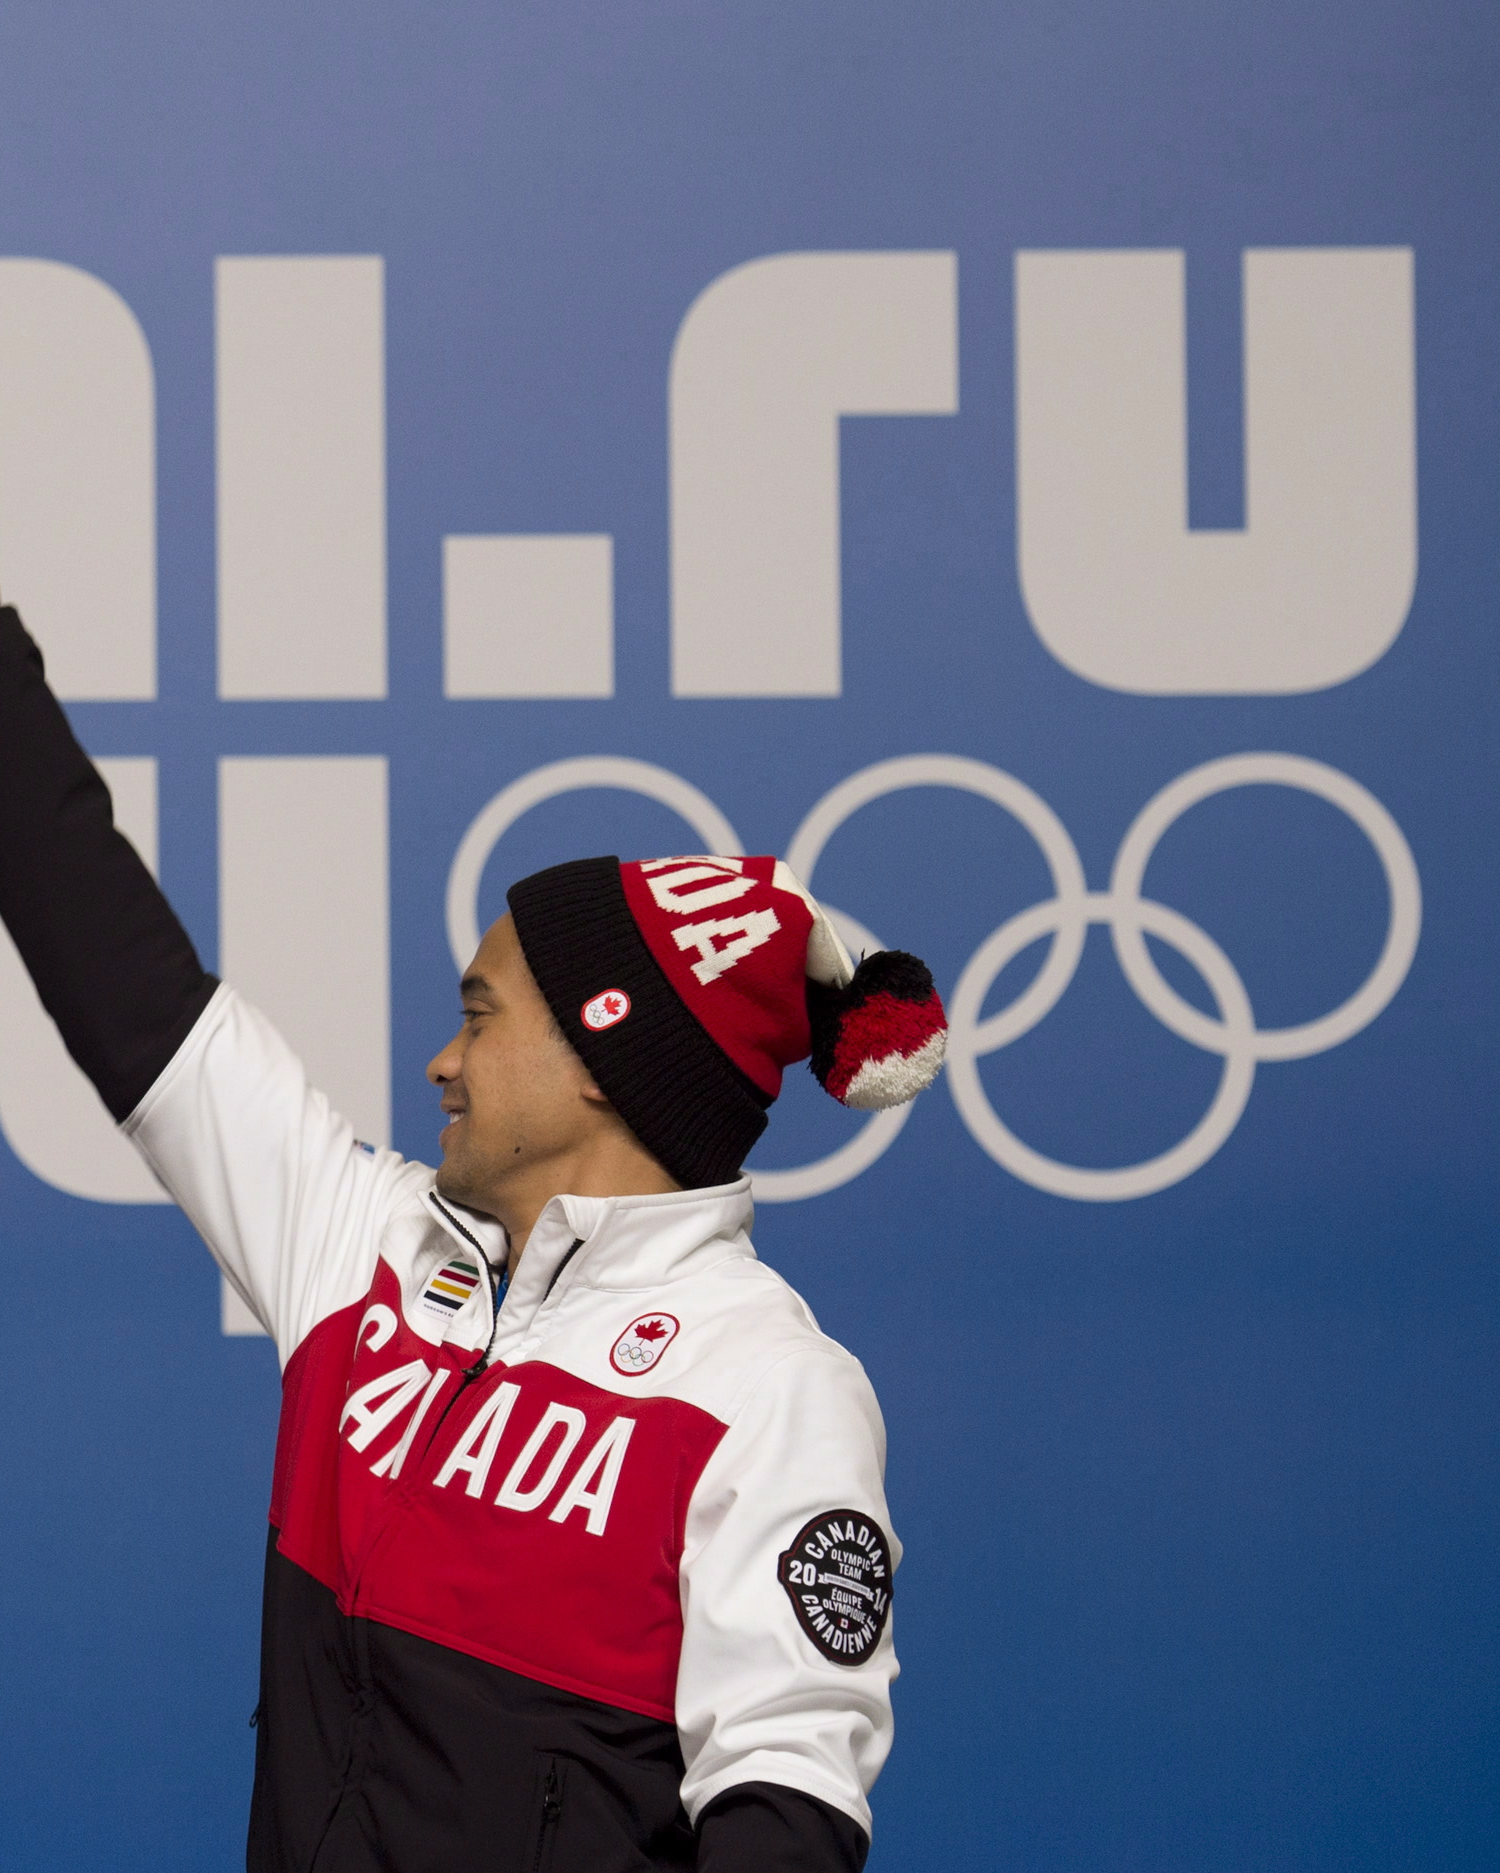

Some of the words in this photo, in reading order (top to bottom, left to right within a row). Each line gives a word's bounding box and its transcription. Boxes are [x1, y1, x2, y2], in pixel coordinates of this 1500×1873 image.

[805, 1521, 885, 1578] CANADIAN
[831, 1549, 871, 1571] OLYMPIC
[789, 1560, 816, 1586] 20
[839, 1562, 862, 1580] TEAM
[831, 1587, 863, 1609] ÉQUIPE
[823, 1599, 866, 1623] OLYMPIQUE
[802, 1595, 877, 1654] CANADIENNE
